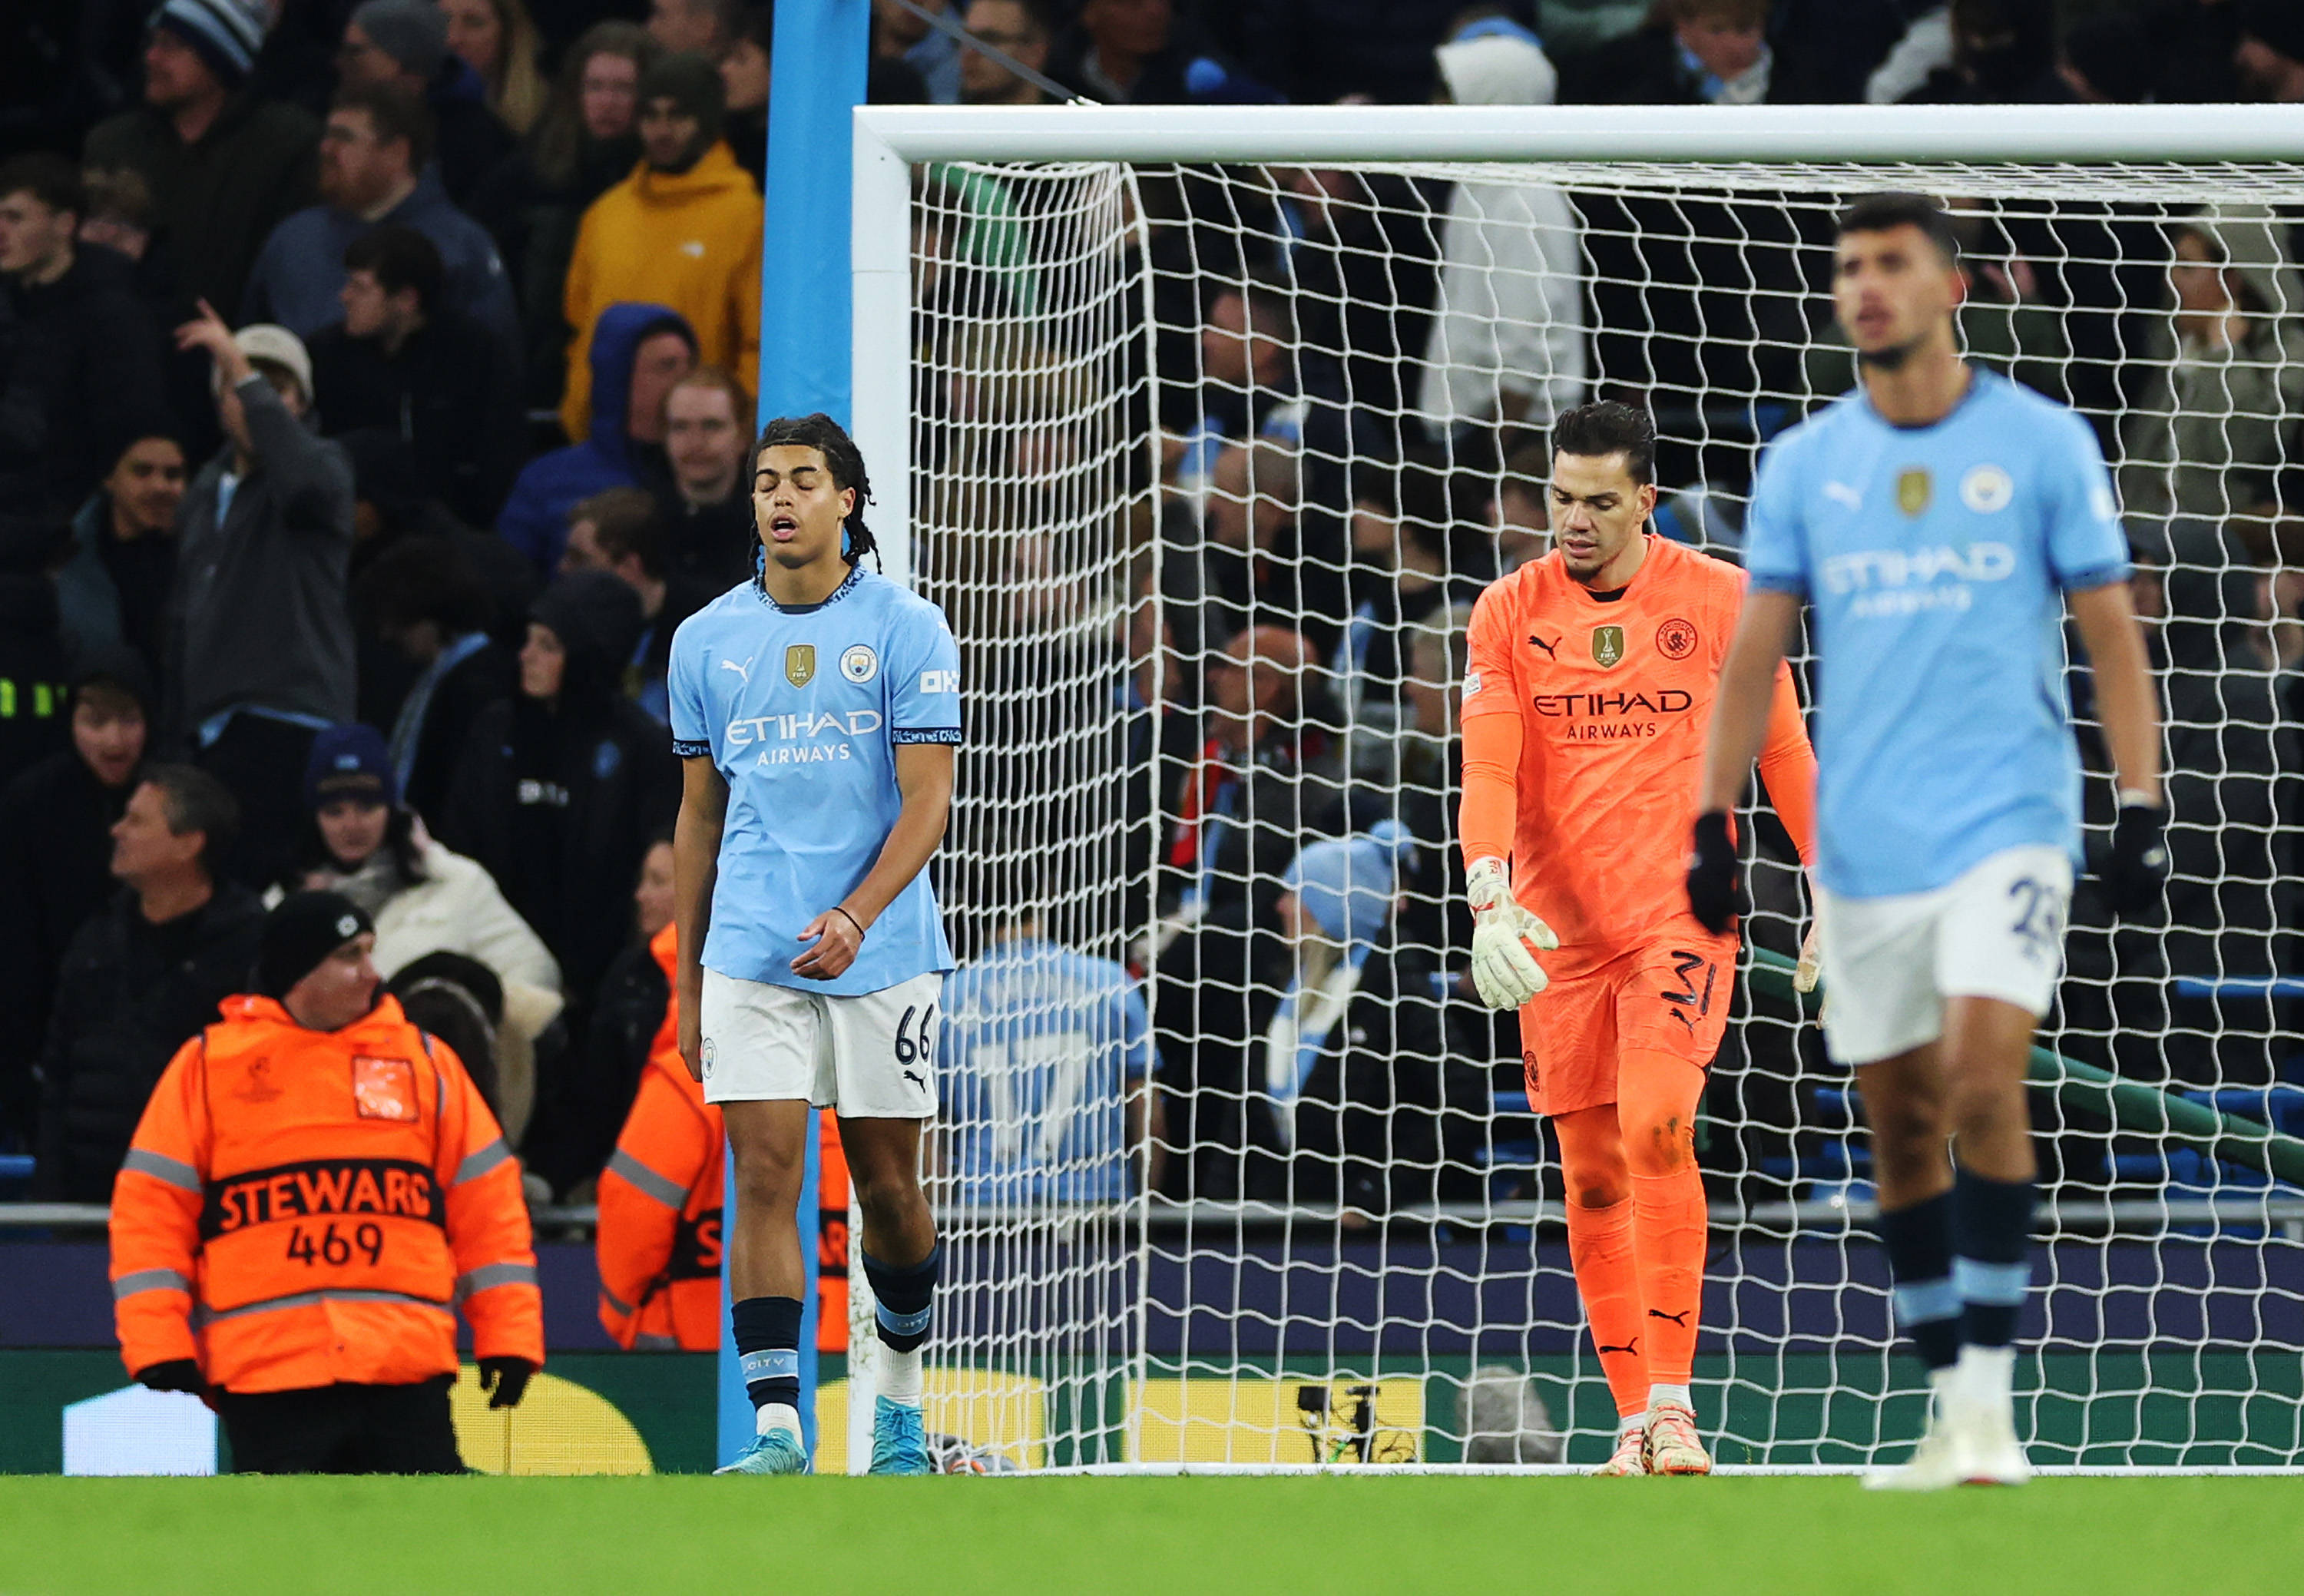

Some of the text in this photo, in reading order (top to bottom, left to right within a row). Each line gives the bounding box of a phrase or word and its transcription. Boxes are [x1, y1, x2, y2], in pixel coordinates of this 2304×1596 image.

[1534, 690, 1692, 717] ETIHAD
[726, 710, 882, 745] ETIHAD
[1567, 723, 1656, 739] AIRWAYS
[756, 743, 850, 766] AIRWAYS
[1660, 950, 1716, 1015] 31
[895, 1003, 935, 1065] 66
[287, 1222, 382, 1267] 469
[748, 1357, 785, 1371] CITY
